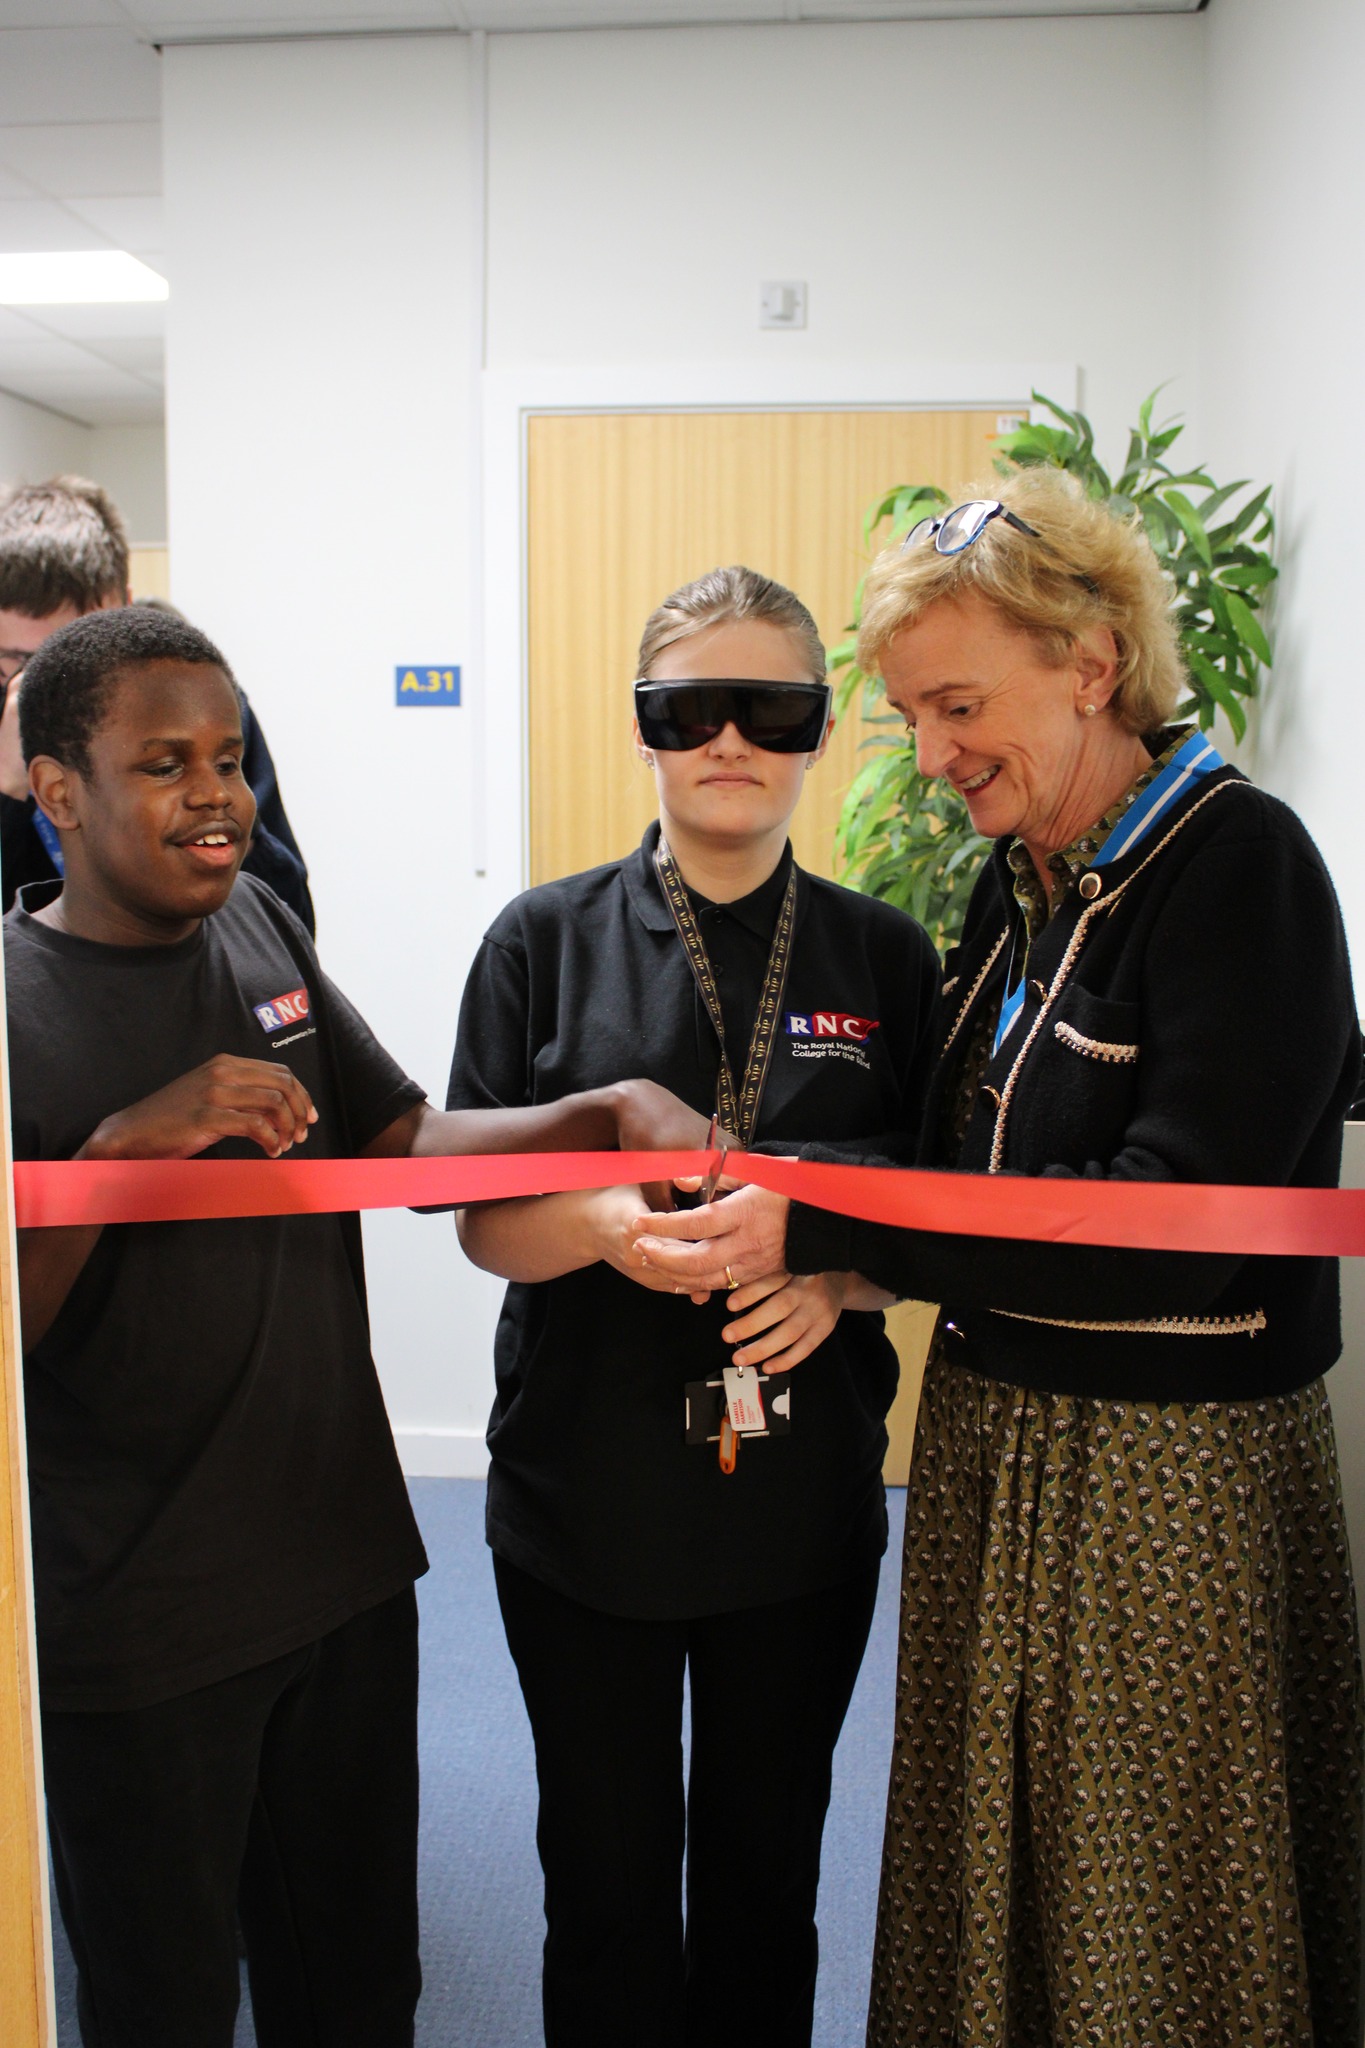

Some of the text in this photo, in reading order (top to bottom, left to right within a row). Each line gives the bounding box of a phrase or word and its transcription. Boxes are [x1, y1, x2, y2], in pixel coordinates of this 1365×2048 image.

[401, 671, 453, 692] A.31
[665, 871, 676, 887] VIP
[672, 891, 683, 907] VIP
[680, 911, 690, 928] VIP
[687, 932, 698, 949] VIP
[694, 954, 705, 970] VIP
[702, 975, 712, 992] VIP
[778, 938, 786, 953] VIP
[774, 958, 783, 973] VIP
[769, 977, 780, 993] VIP
[258, 995, 309, 1028] RNC
[765, 998, 775, 1014] VIP
[760, 1019, 771, 1035] VIP
[790, 1015, 863, 1038] RNC
[756, 1041, 767, 1058] VIP
[792, 1042, 809, 1050] The
[810, 1042, 835, 1050] Royal
[792, 1050, 827, 1058] College
[828, 1049, 842, 1057] for
[841, 1051, 855, 1062] the
[751, 1064, 761, 1081] VIP
[721, 1092, 731, 1111] VIP
[746, 1087, 756, 1105] VIP
